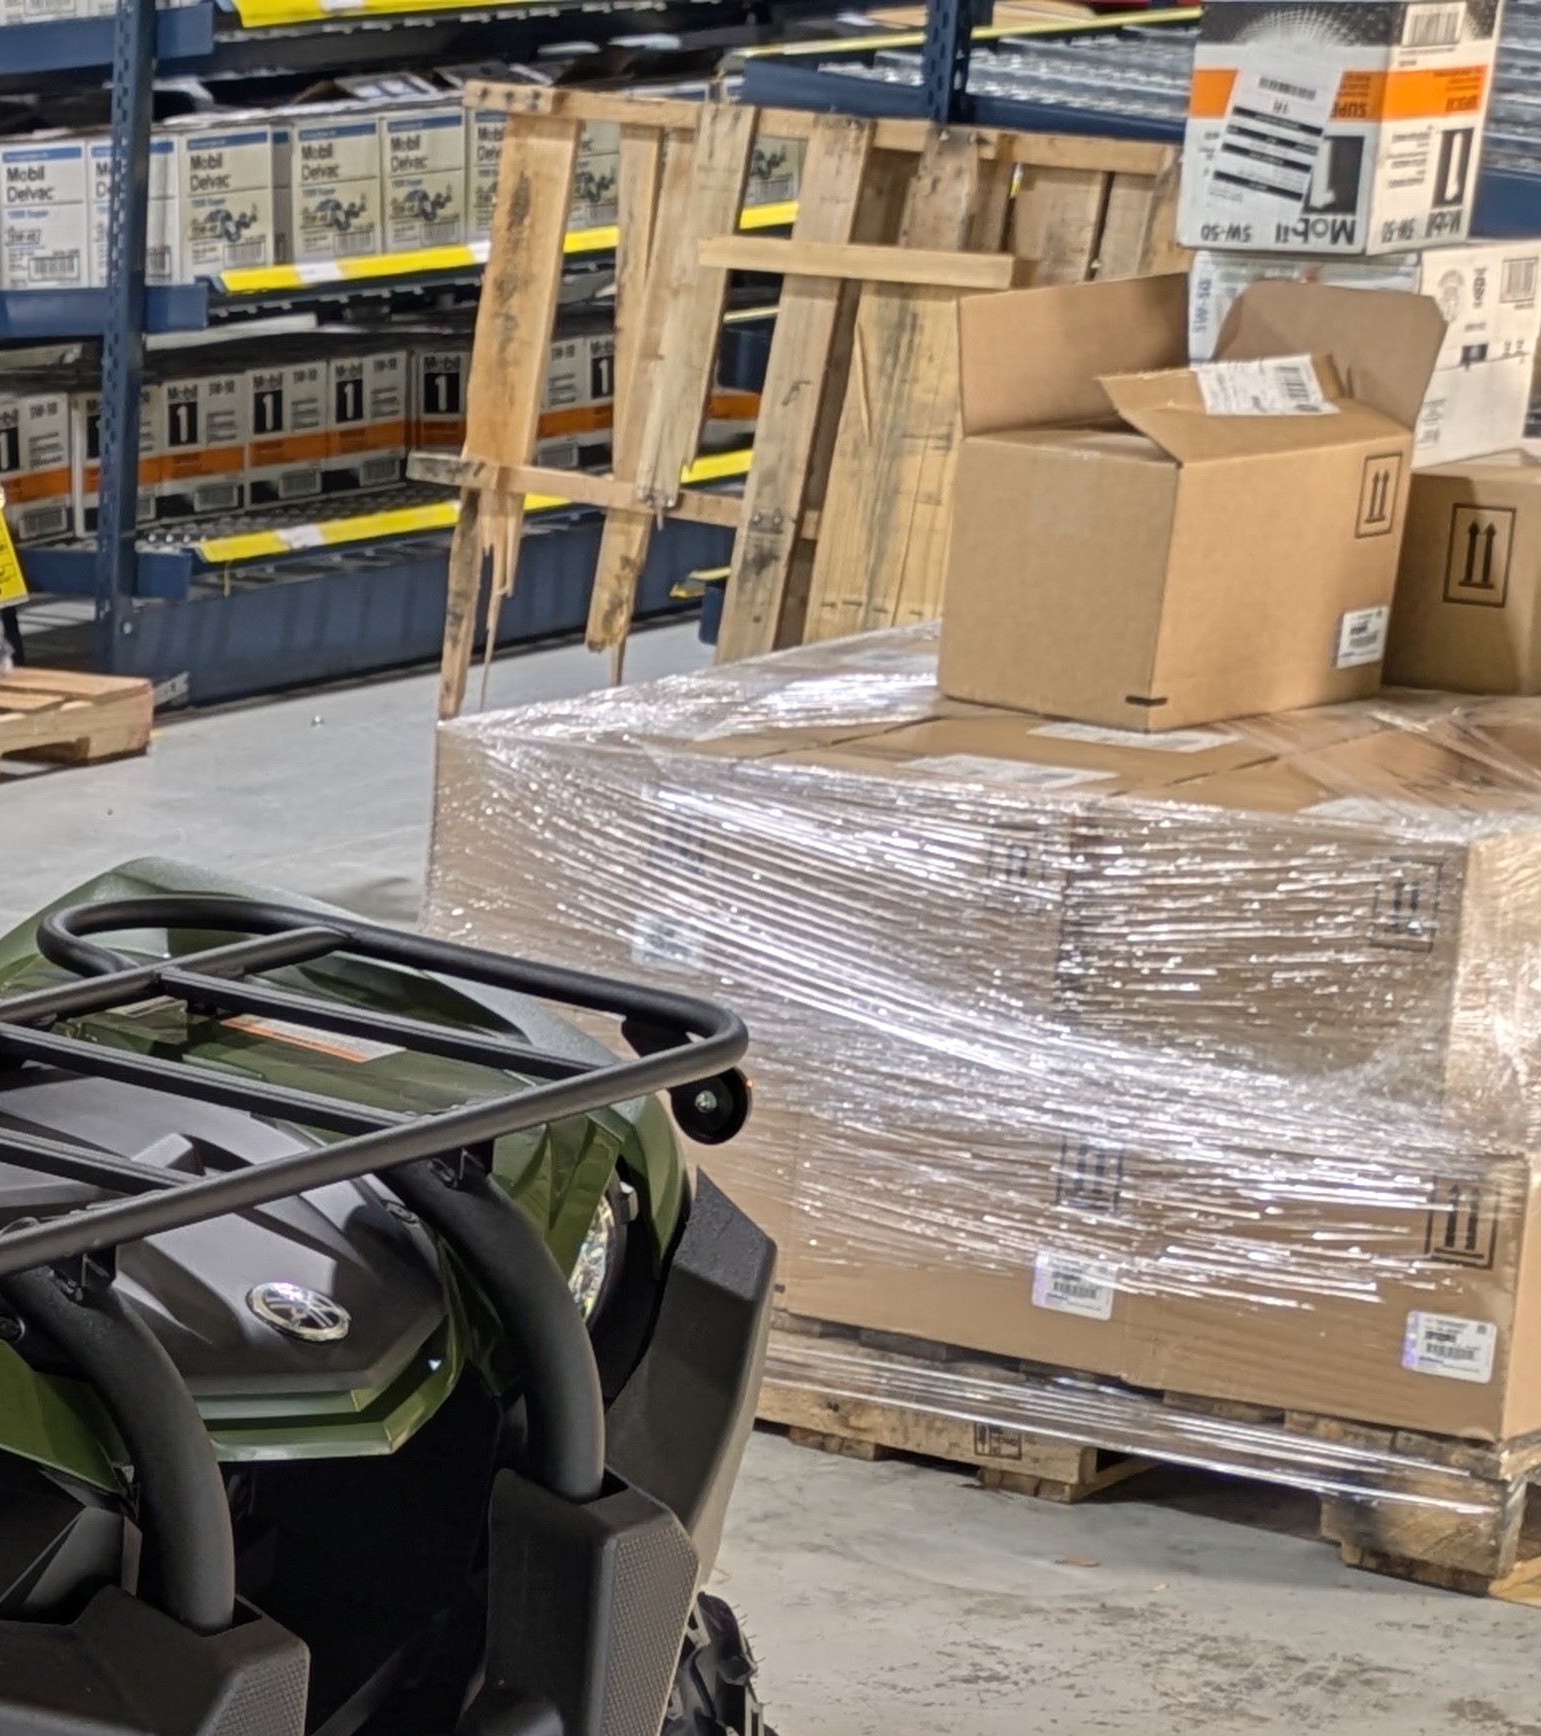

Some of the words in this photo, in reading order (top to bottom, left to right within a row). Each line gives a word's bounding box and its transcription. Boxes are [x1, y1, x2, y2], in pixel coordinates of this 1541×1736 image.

[301, 143, 334, 161] Mobil
[391, 134, 422, 152] Mobil
[190, 152, 223, 172] Mobil
[391, 155, 429, 174] Delvac
[7, 166, 45, 182] Mobil
[301, 163, 341, 182] Delvac
[190, 173, 232, 192] Delvac
[7, 186, 55, 202] Delvac
[1275, 217, 1356, 246] Mobil
[344, 382, 356, 419] 1
[435, 374, 448, 411] 1
[263, 393, 274, 430] 1
[176, 405, 188, 442] 1
